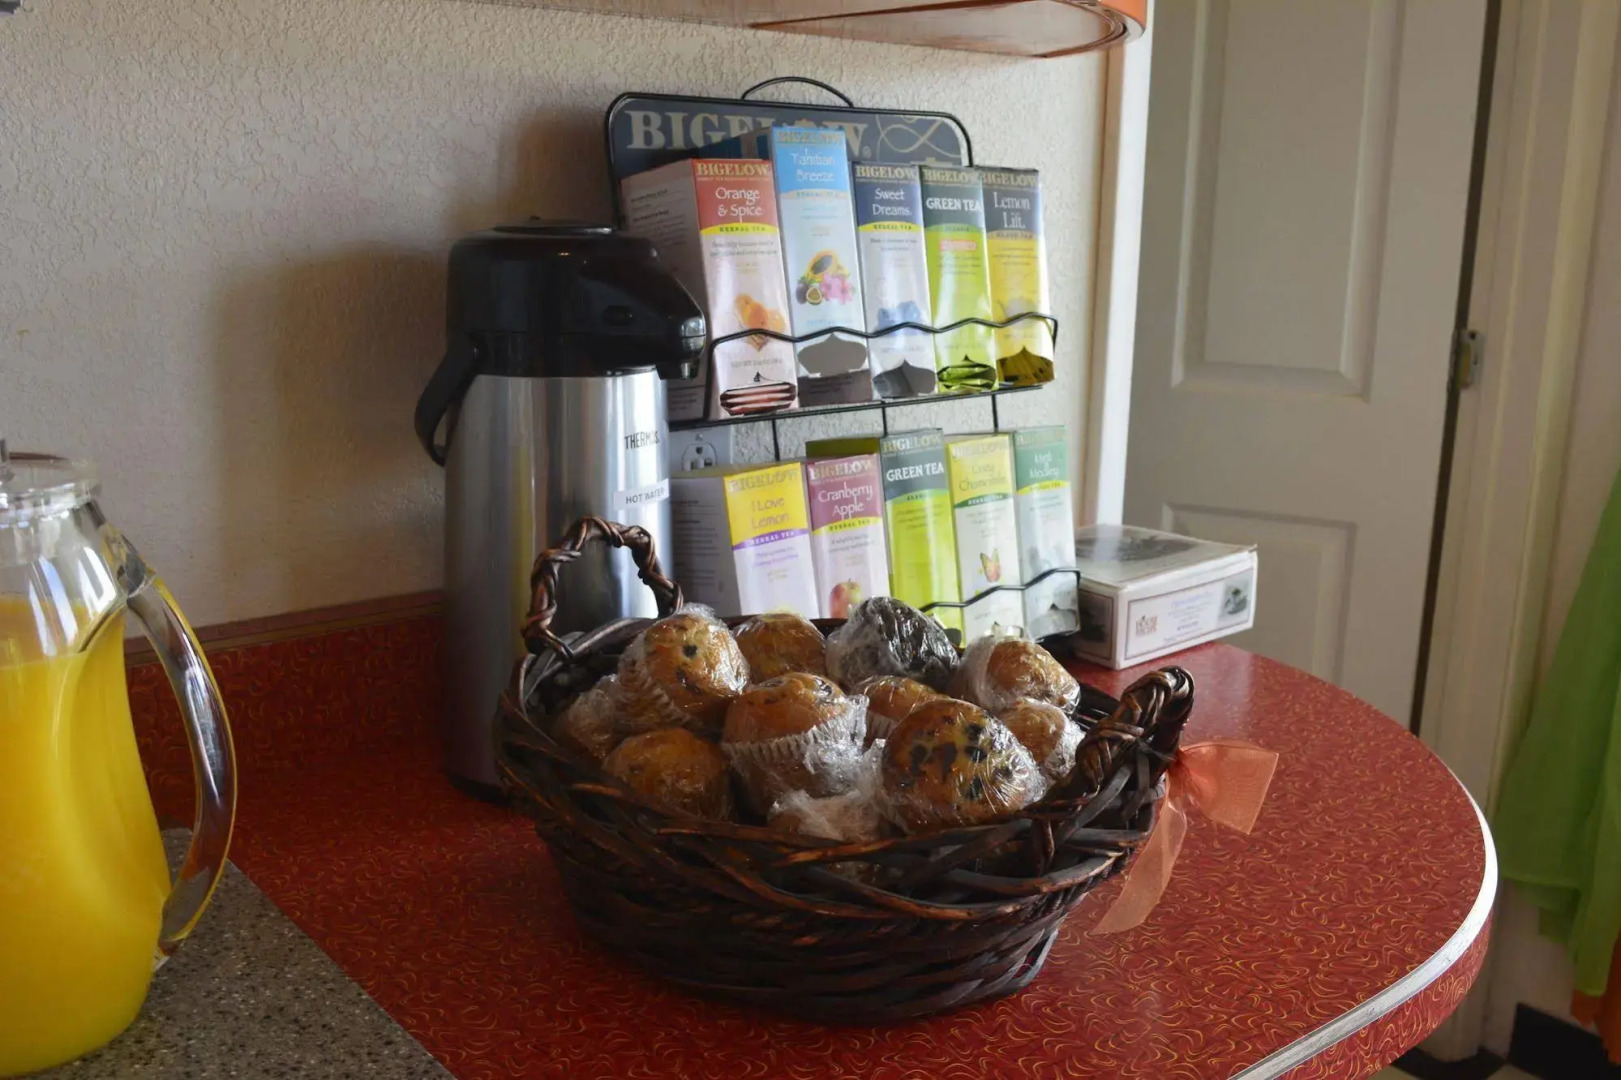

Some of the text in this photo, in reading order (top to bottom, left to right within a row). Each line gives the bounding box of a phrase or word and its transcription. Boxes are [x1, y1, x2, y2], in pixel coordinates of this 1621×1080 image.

[625, 110, 869, 157] BIGEW
[697, 163, 769, 176] BIGELOW
[856, 165, 916, 178] BIGELOW
[715, 187, 761, 206] Orange
[874, 188, 905, 201] Sweet
[993, 191, 1030, 210] Lemon
[718, 203, 763, 223] & Spice
[926, 197, 984, 213] GREEN TEA
[809, 460, 875, 480] BIGELOW
[886, 462, 944, 482] GREEN TEA
[625, 487, 665, 504] HOT WATER
[818, 482, 873, 502] Cranberry
[752, 497, 785, 512] I Love
[832, 498, 864, 521] Apple
[752, 513, 790, 530] Lemon
